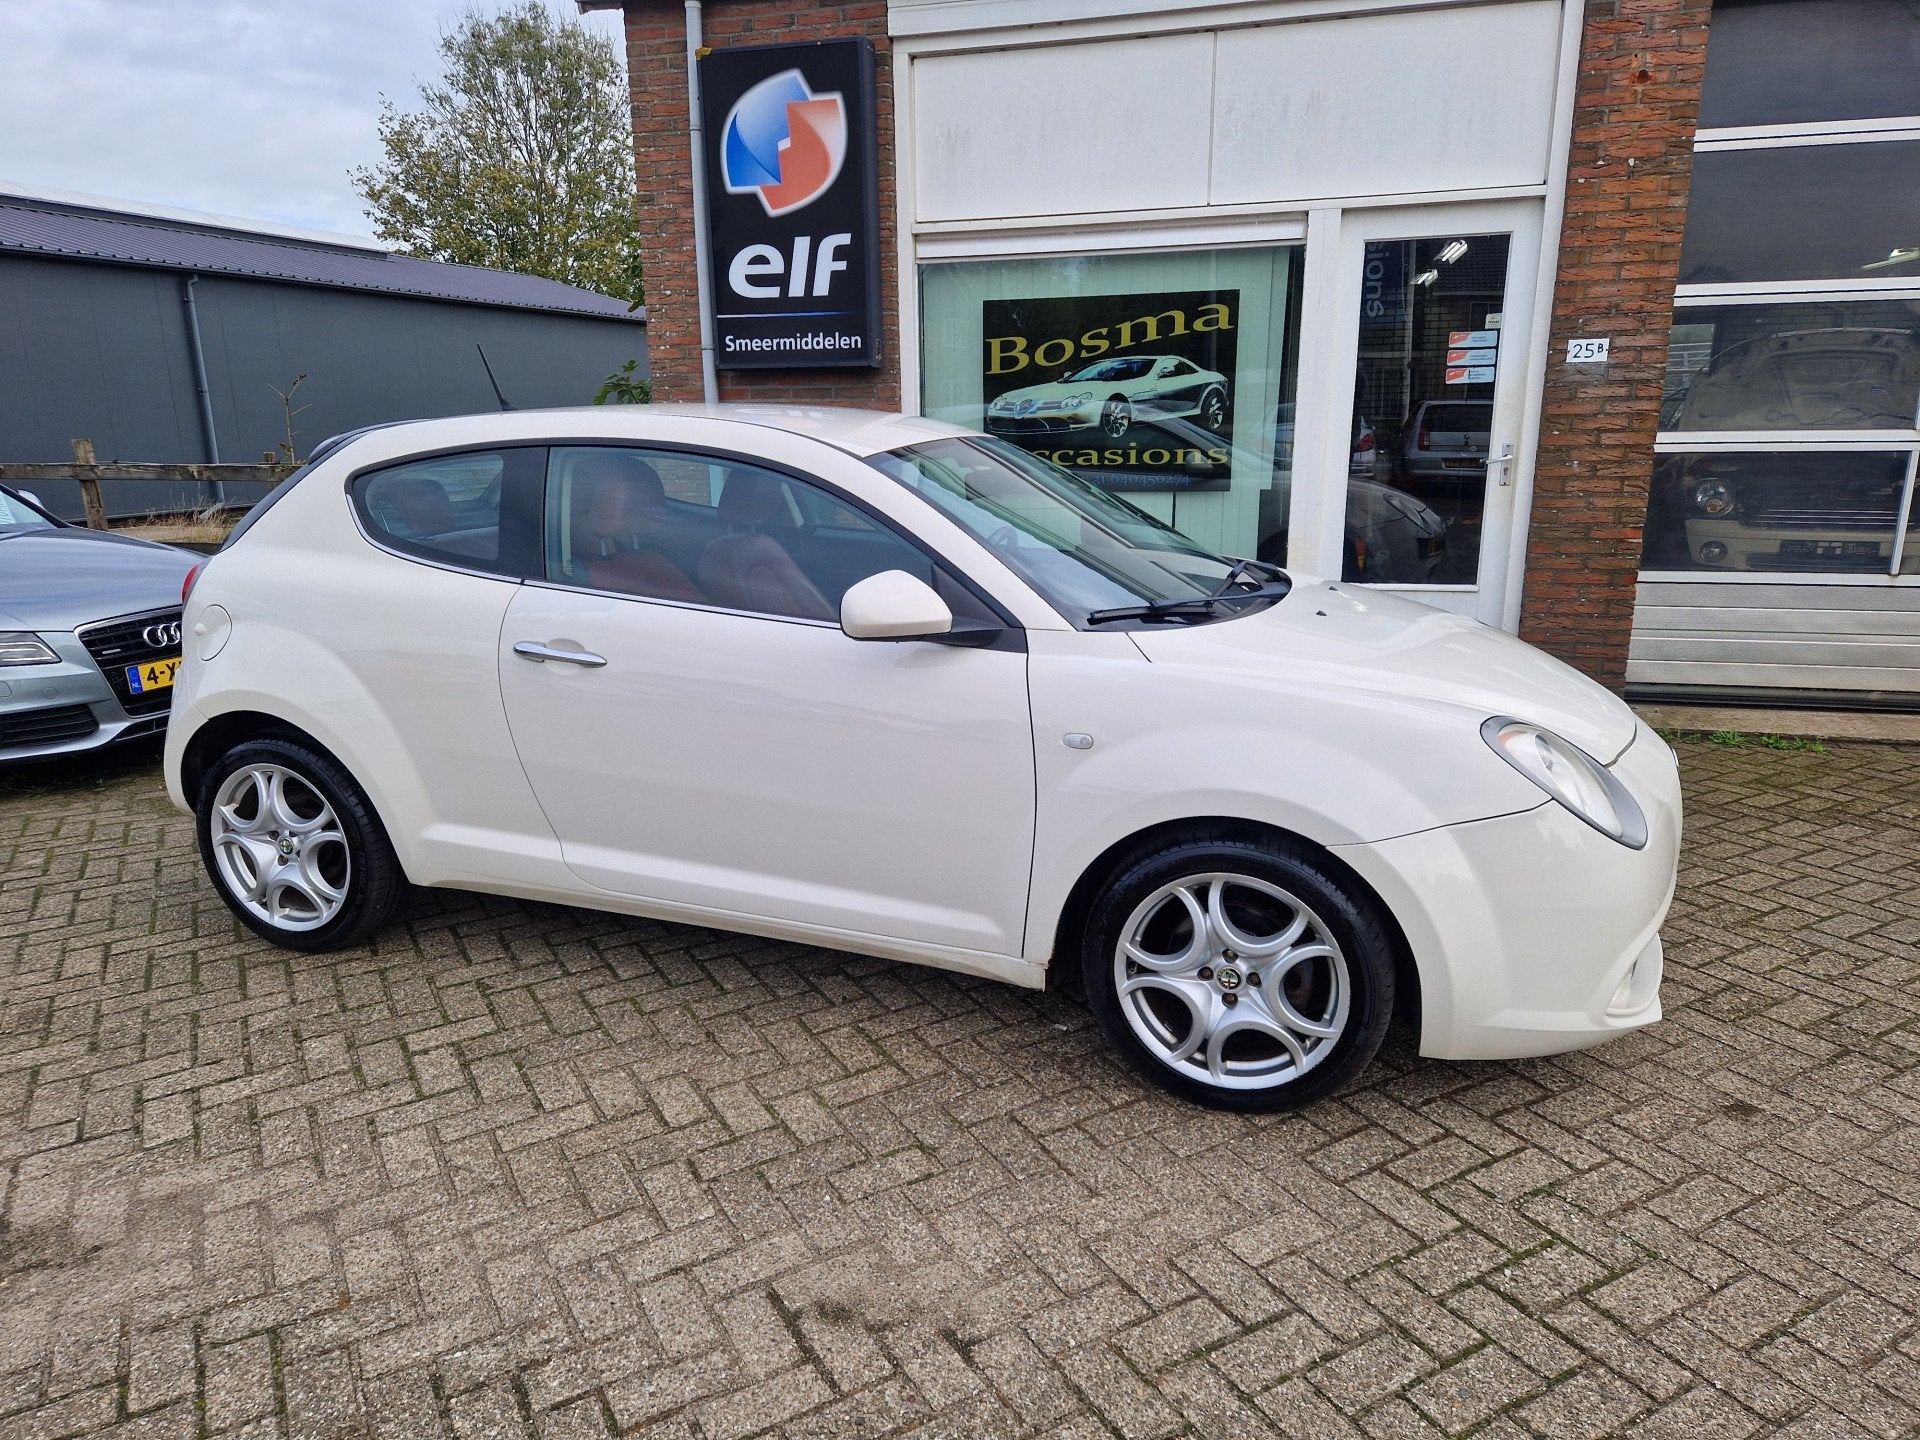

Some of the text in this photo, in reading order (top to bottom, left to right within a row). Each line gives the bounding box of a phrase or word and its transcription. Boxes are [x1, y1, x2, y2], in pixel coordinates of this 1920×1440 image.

[728, 232, 852, 299] elf
[724, 331, 862, 352] Smeermiddelen
[985, 303, 1235, 375] Bosma
